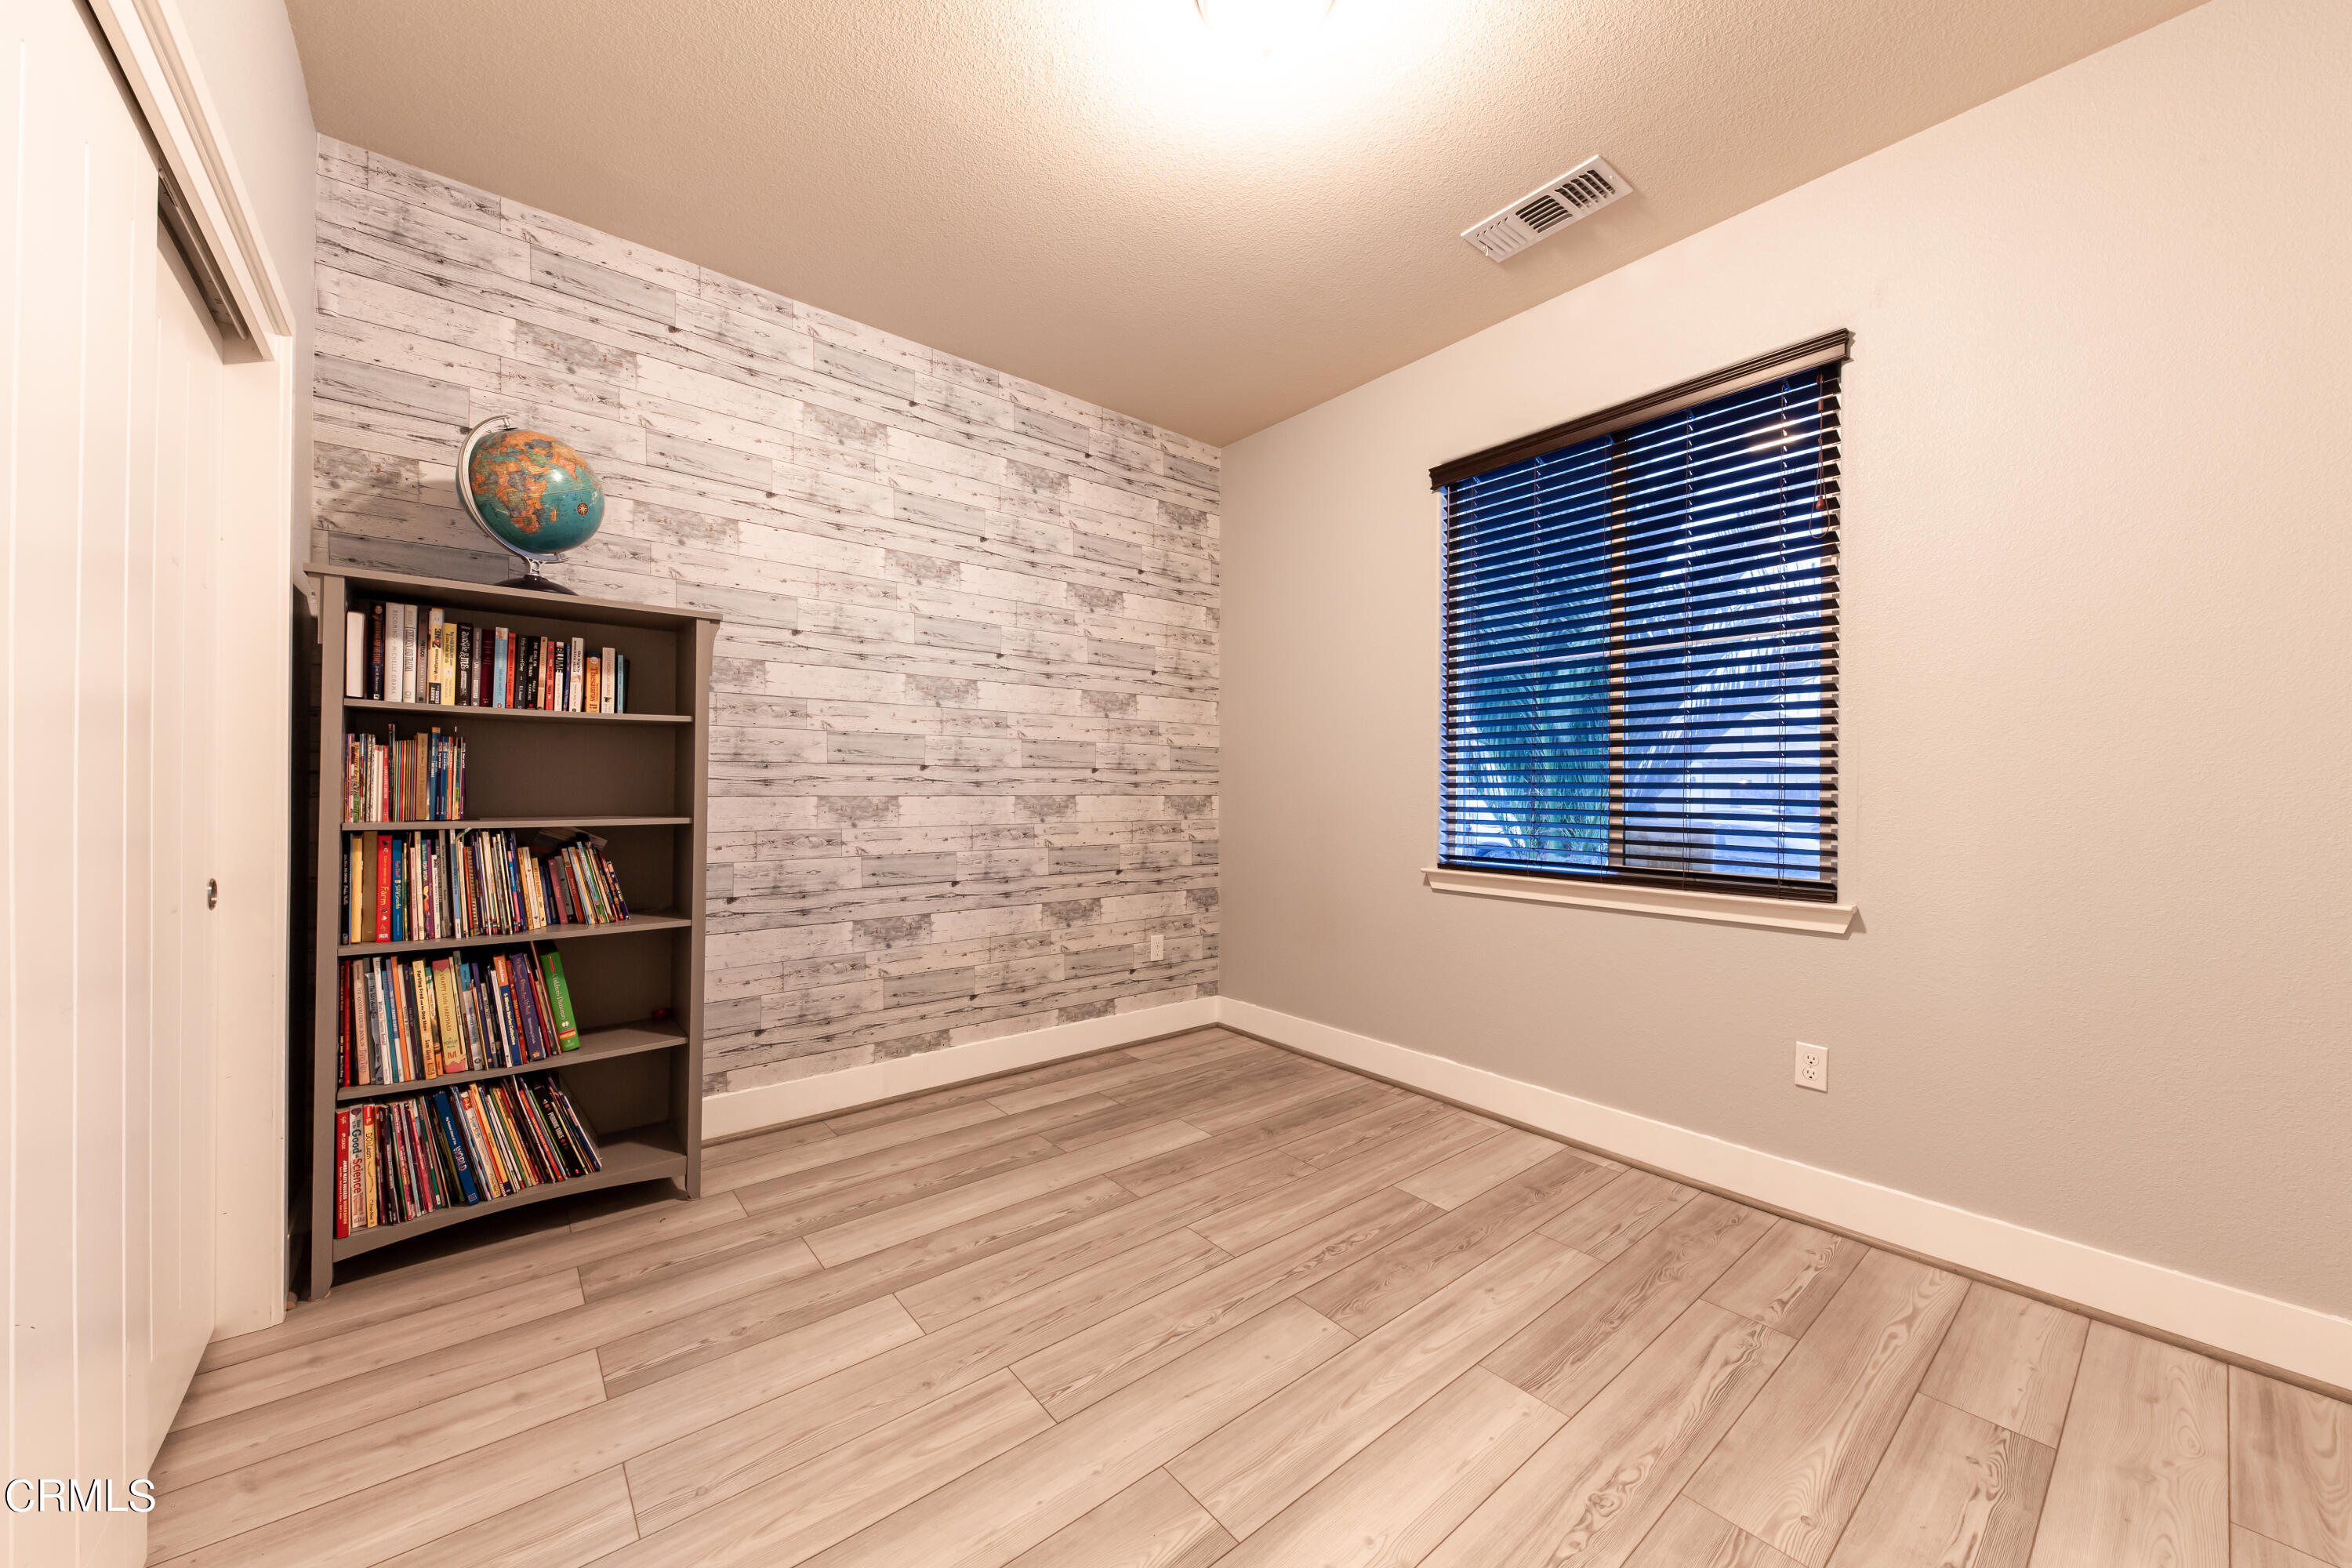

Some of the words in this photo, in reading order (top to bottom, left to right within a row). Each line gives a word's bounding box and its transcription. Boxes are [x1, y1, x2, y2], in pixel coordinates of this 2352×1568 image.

[380, 886, 389, 905] Farm
[557, 996, 566, 1020] Dictionary
[548, 1112, 559, 1129] PERIODIC
[556, 1127, 564, 1139] TABLE
[351, 1129, 362, 1154] Good
[453, 1145, 467, 1171] WORLD
[353, 1158, 364, 1193] Science
